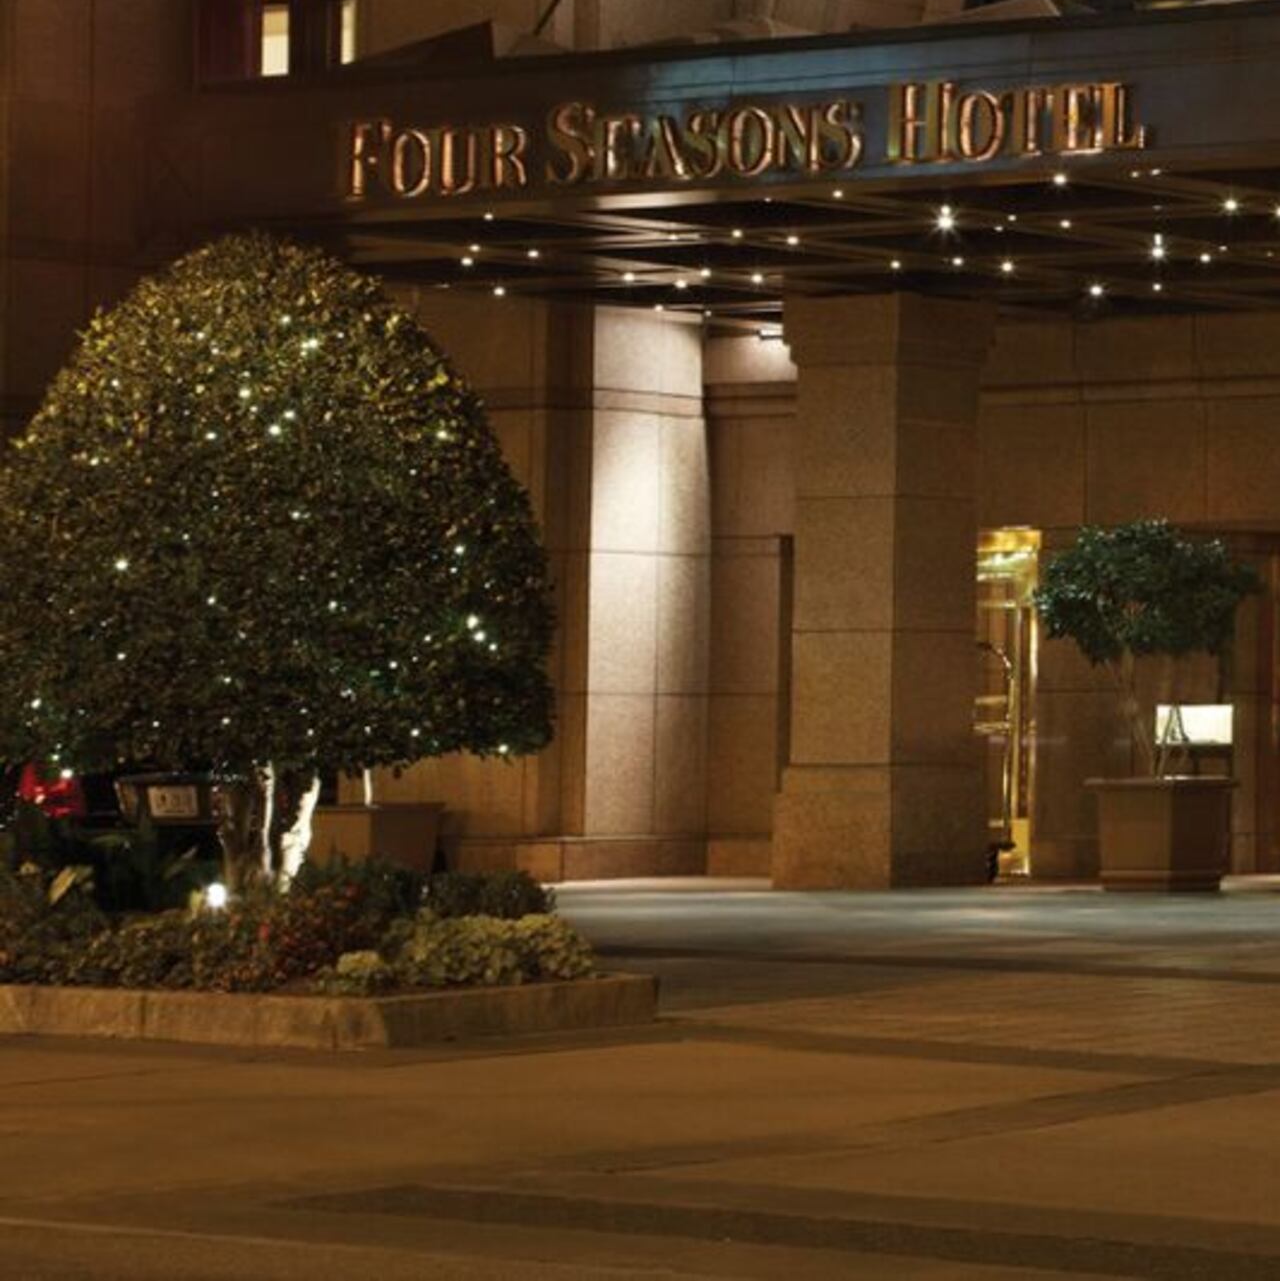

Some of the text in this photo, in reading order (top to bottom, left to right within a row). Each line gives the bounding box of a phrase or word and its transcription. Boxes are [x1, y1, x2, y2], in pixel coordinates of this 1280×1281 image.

[344, 81, 1147, 202] FOUR SEASONS HOTEL
